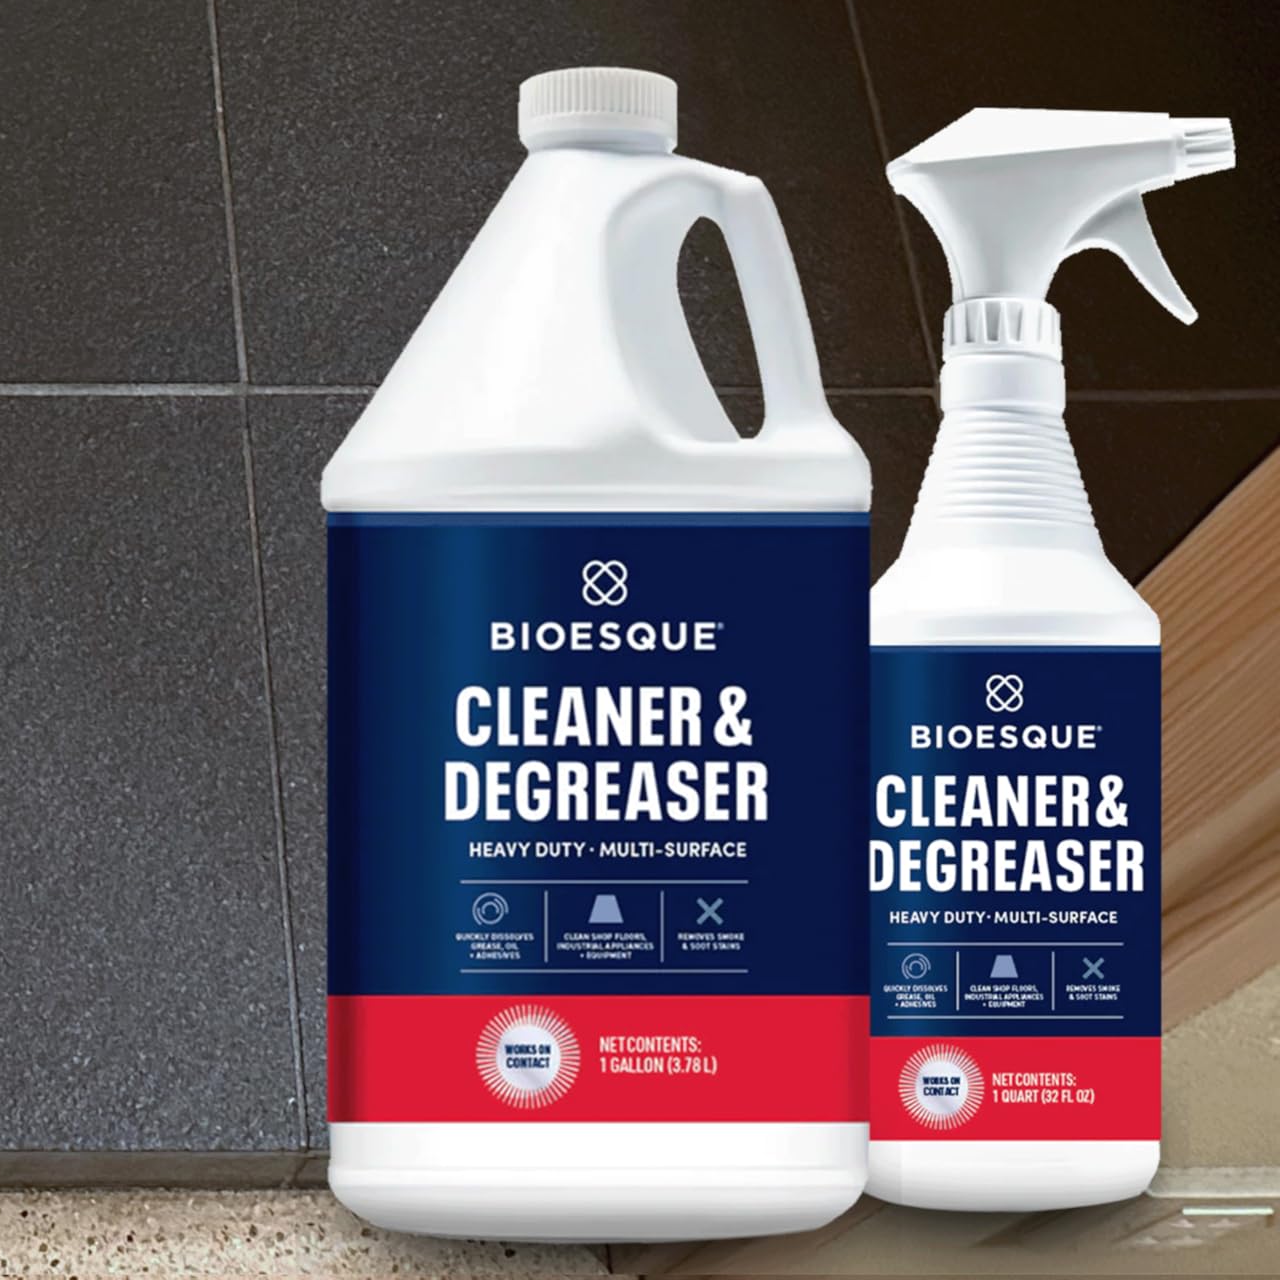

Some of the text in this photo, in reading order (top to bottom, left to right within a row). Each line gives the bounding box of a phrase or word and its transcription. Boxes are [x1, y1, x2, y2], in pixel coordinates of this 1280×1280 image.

[491, 622, 722, 650] BIOESQUE
[456, 686, 752, 746] CLEANER &
[911, 725, 1101, 748] BIOESQUE
[445, 761, 767, 821] DEGREASER
[876, 775, 1128, 827] CLEANER &
[469, 841, 531, 858] HEAVY
[535, 841, 586, 858] DUTY
[599, 841, 747, 858] MULTI-SURFACE
[870, 839, 1143, 892] DEGREASER
[889, 910, 941, 924] HEAVY
[943, 910, 986, 924] DUTY
[993, 910, 1118, 924] MULTI-SURFACE
[504, 1044, 551, 1055] WORKS ON
[505, 1056, 550, 1069] CONTACT
[599, 1055, 718, 1076] 1 GALLON (3.78 L)
[922, 1076, 950, 1086] WORKS
[922, 1086, 960, 1097] CONTACT
[992, 1087, 1096, 1105] 1 QUART (32 FL OZ)
